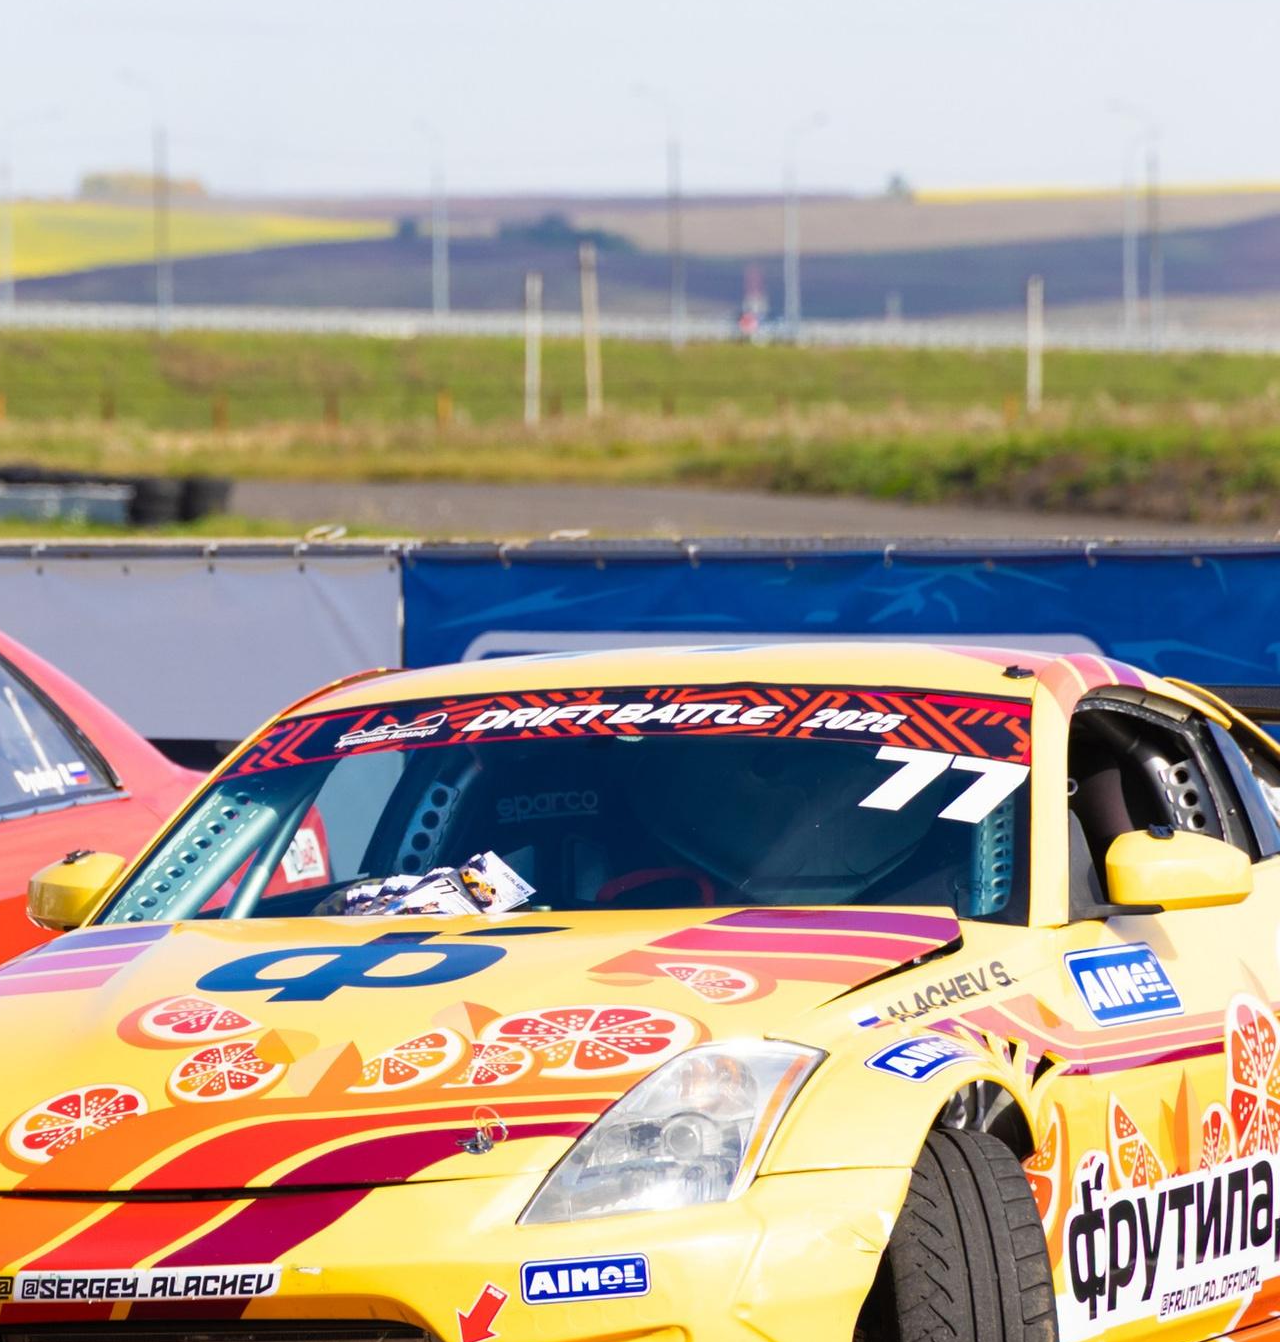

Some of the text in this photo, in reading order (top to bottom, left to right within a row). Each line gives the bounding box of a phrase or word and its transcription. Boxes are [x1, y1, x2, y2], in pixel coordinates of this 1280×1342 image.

[461, 702, 907, 735] DRIFT BATTLE 2025
[496, 789, 599, 822] sparco
[858, 745, 1030, 824] 77
[433, 879, 459, 895] 77
[887, 960, 1019, 1022] ALACHEV S.
[1079, 959, 1176, 1011] AIMOL
[1069, 1160, 1280, 1320] фрутила
[21, 1263, 274, 1300] @SERGEY_ALACHEV
[528, 1263, 644, 1296] AIMOL
[1159, 1264, 1261, 1317] @FRUTILAD.OFFICIAL
